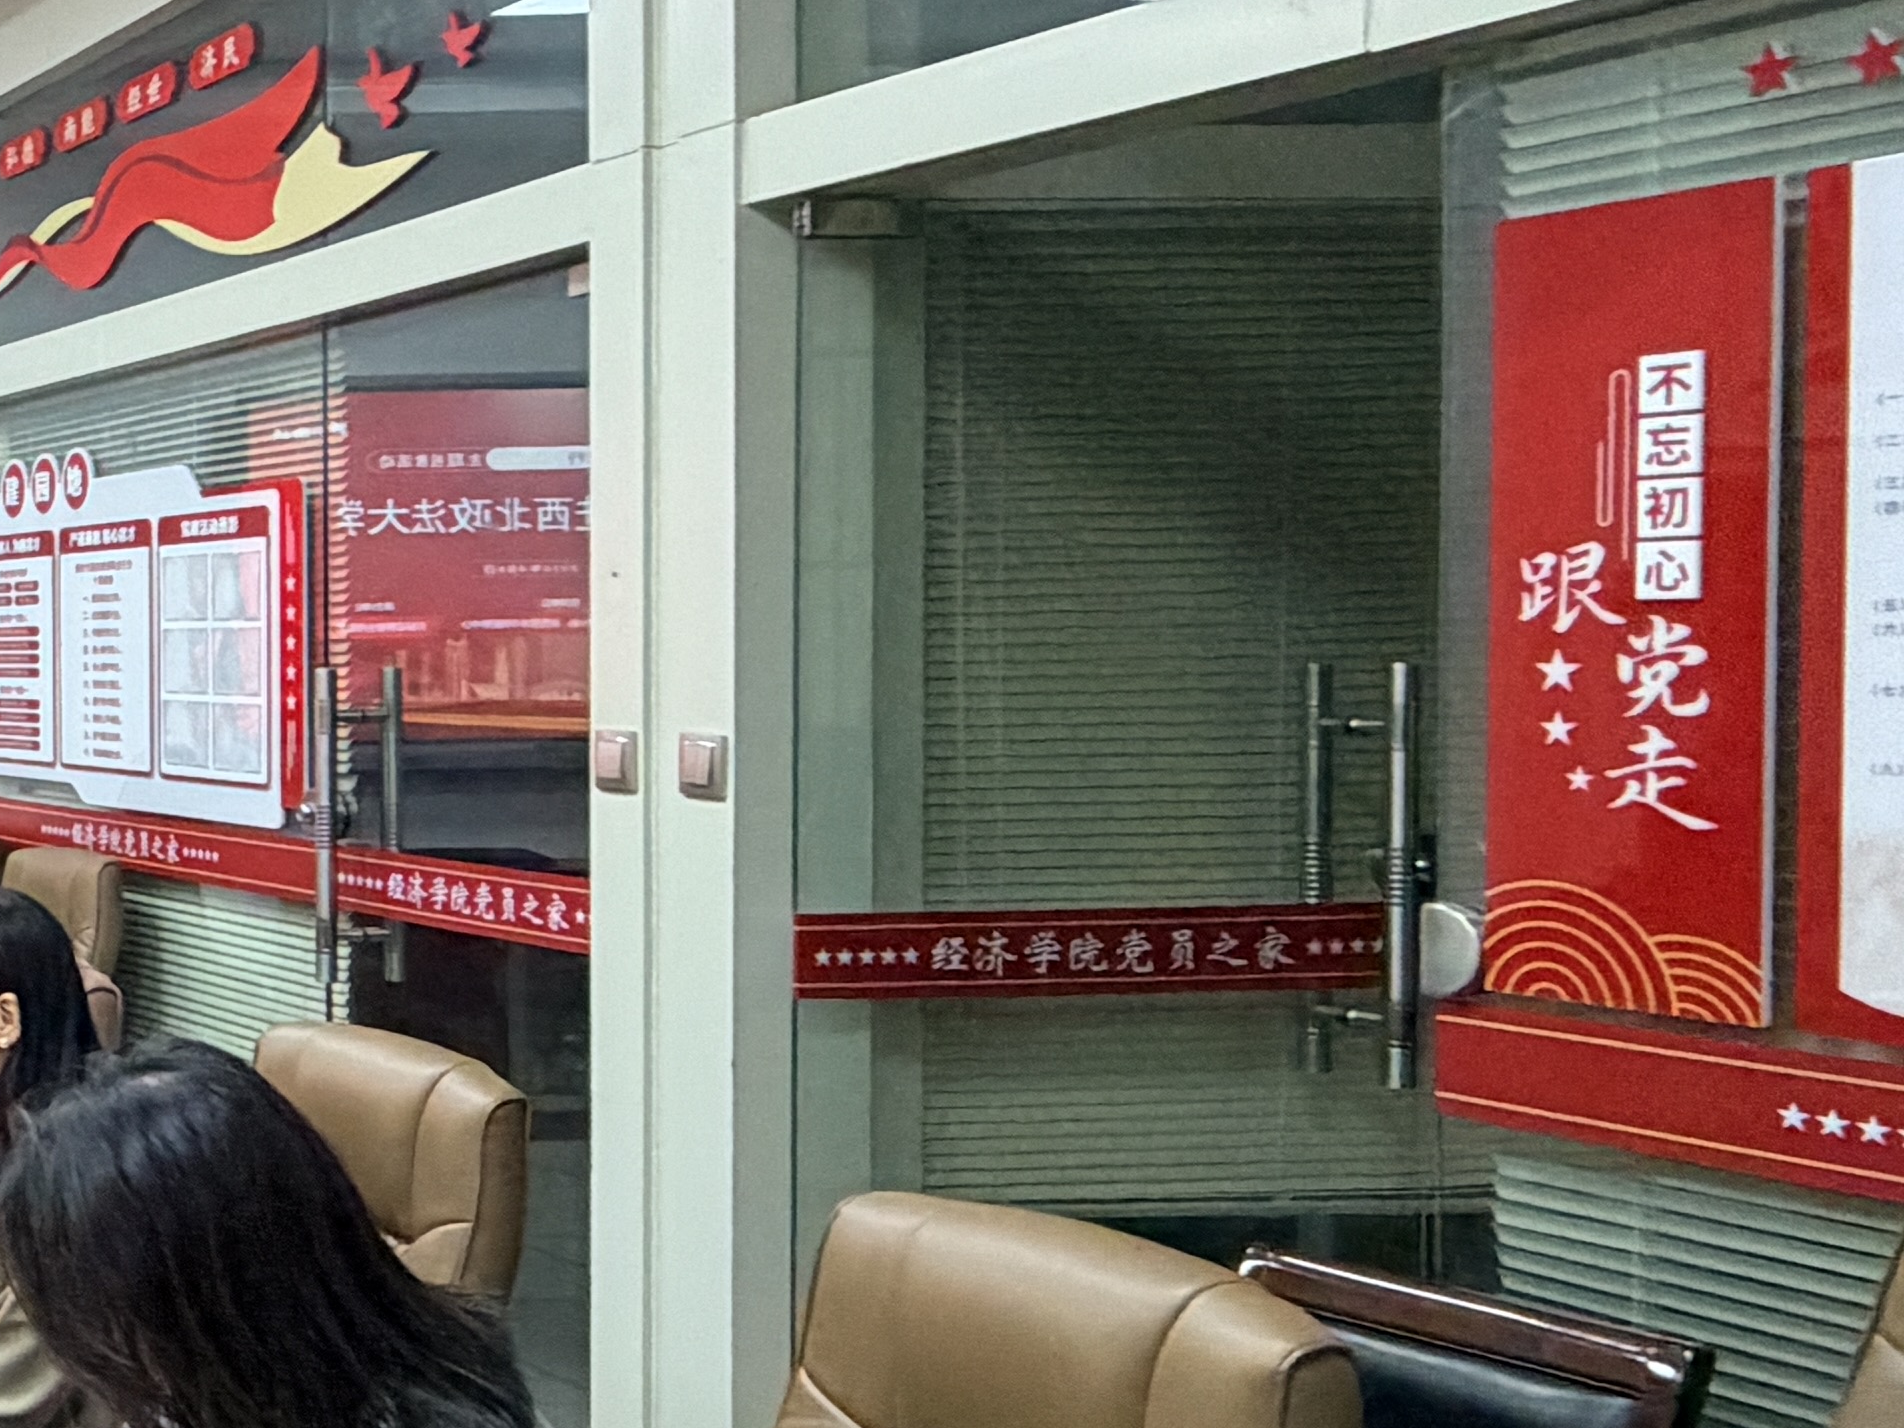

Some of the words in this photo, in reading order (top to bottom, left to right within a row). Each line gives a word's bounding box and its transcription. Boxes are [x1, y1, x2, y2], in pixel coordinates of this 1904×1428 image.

[1642, 361, 1693, 592] 不忘初心
[1517, 541, 1720, 831] 跟党走
